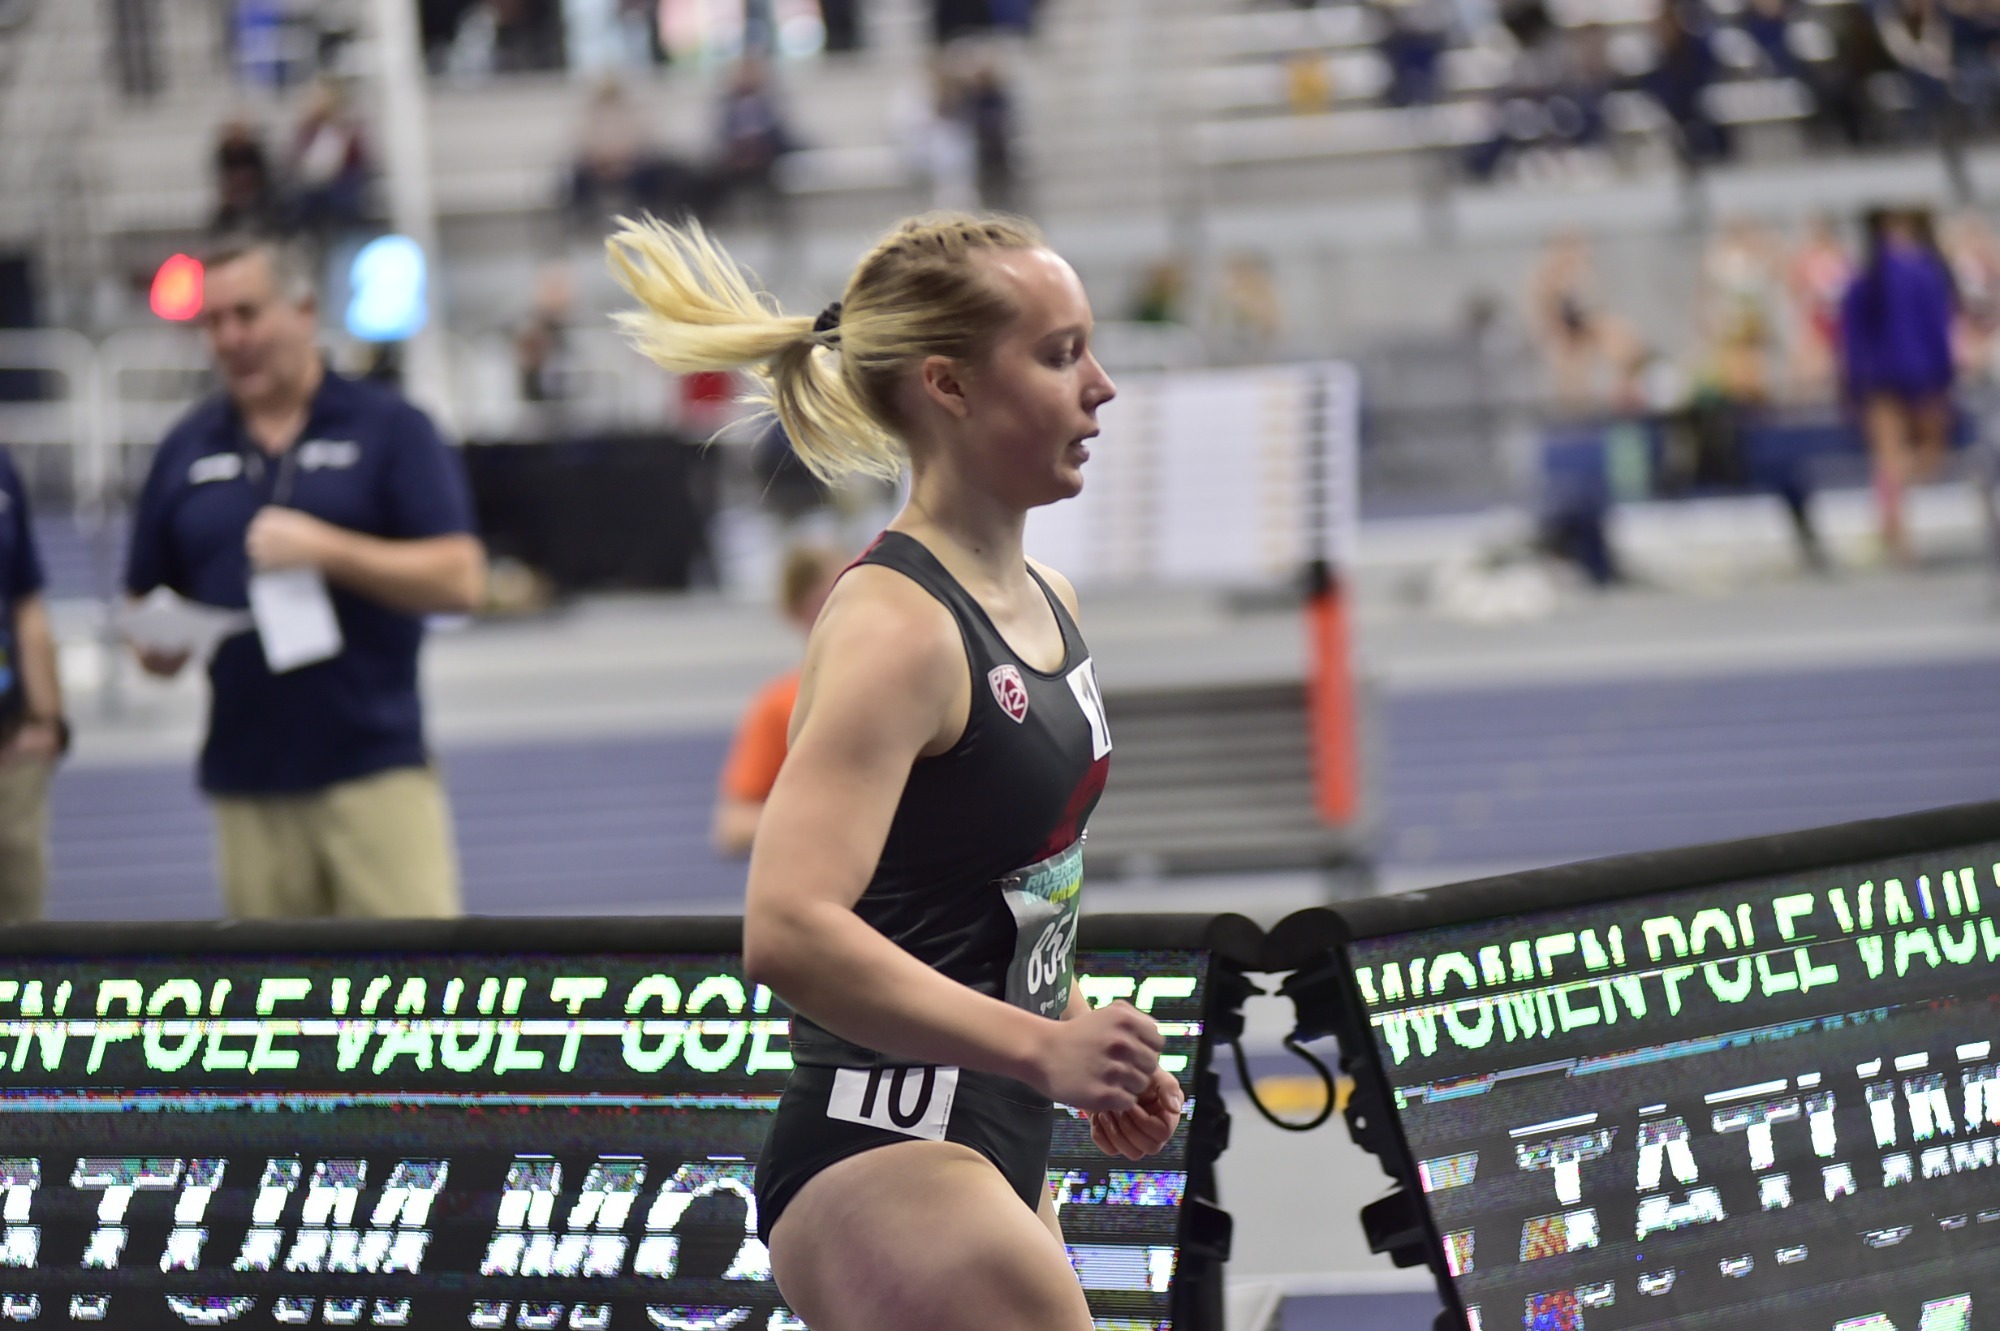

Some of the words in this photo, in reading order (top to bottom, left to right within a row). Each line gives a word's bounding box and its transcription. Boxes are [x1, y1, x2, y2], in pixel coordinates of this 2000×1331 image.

[1004, 689, 1024, 712] 12
[1356, 924, 1648, 1066] WOMEN
[1643, 892, 1838, 1017] POLE
[1828, 863, 2000, 980] VAUL
[87, 978, 311, 1075] POLE
[330, 975, 608, 1075] VAULT
[859, 1066, 936, 1129] 10
